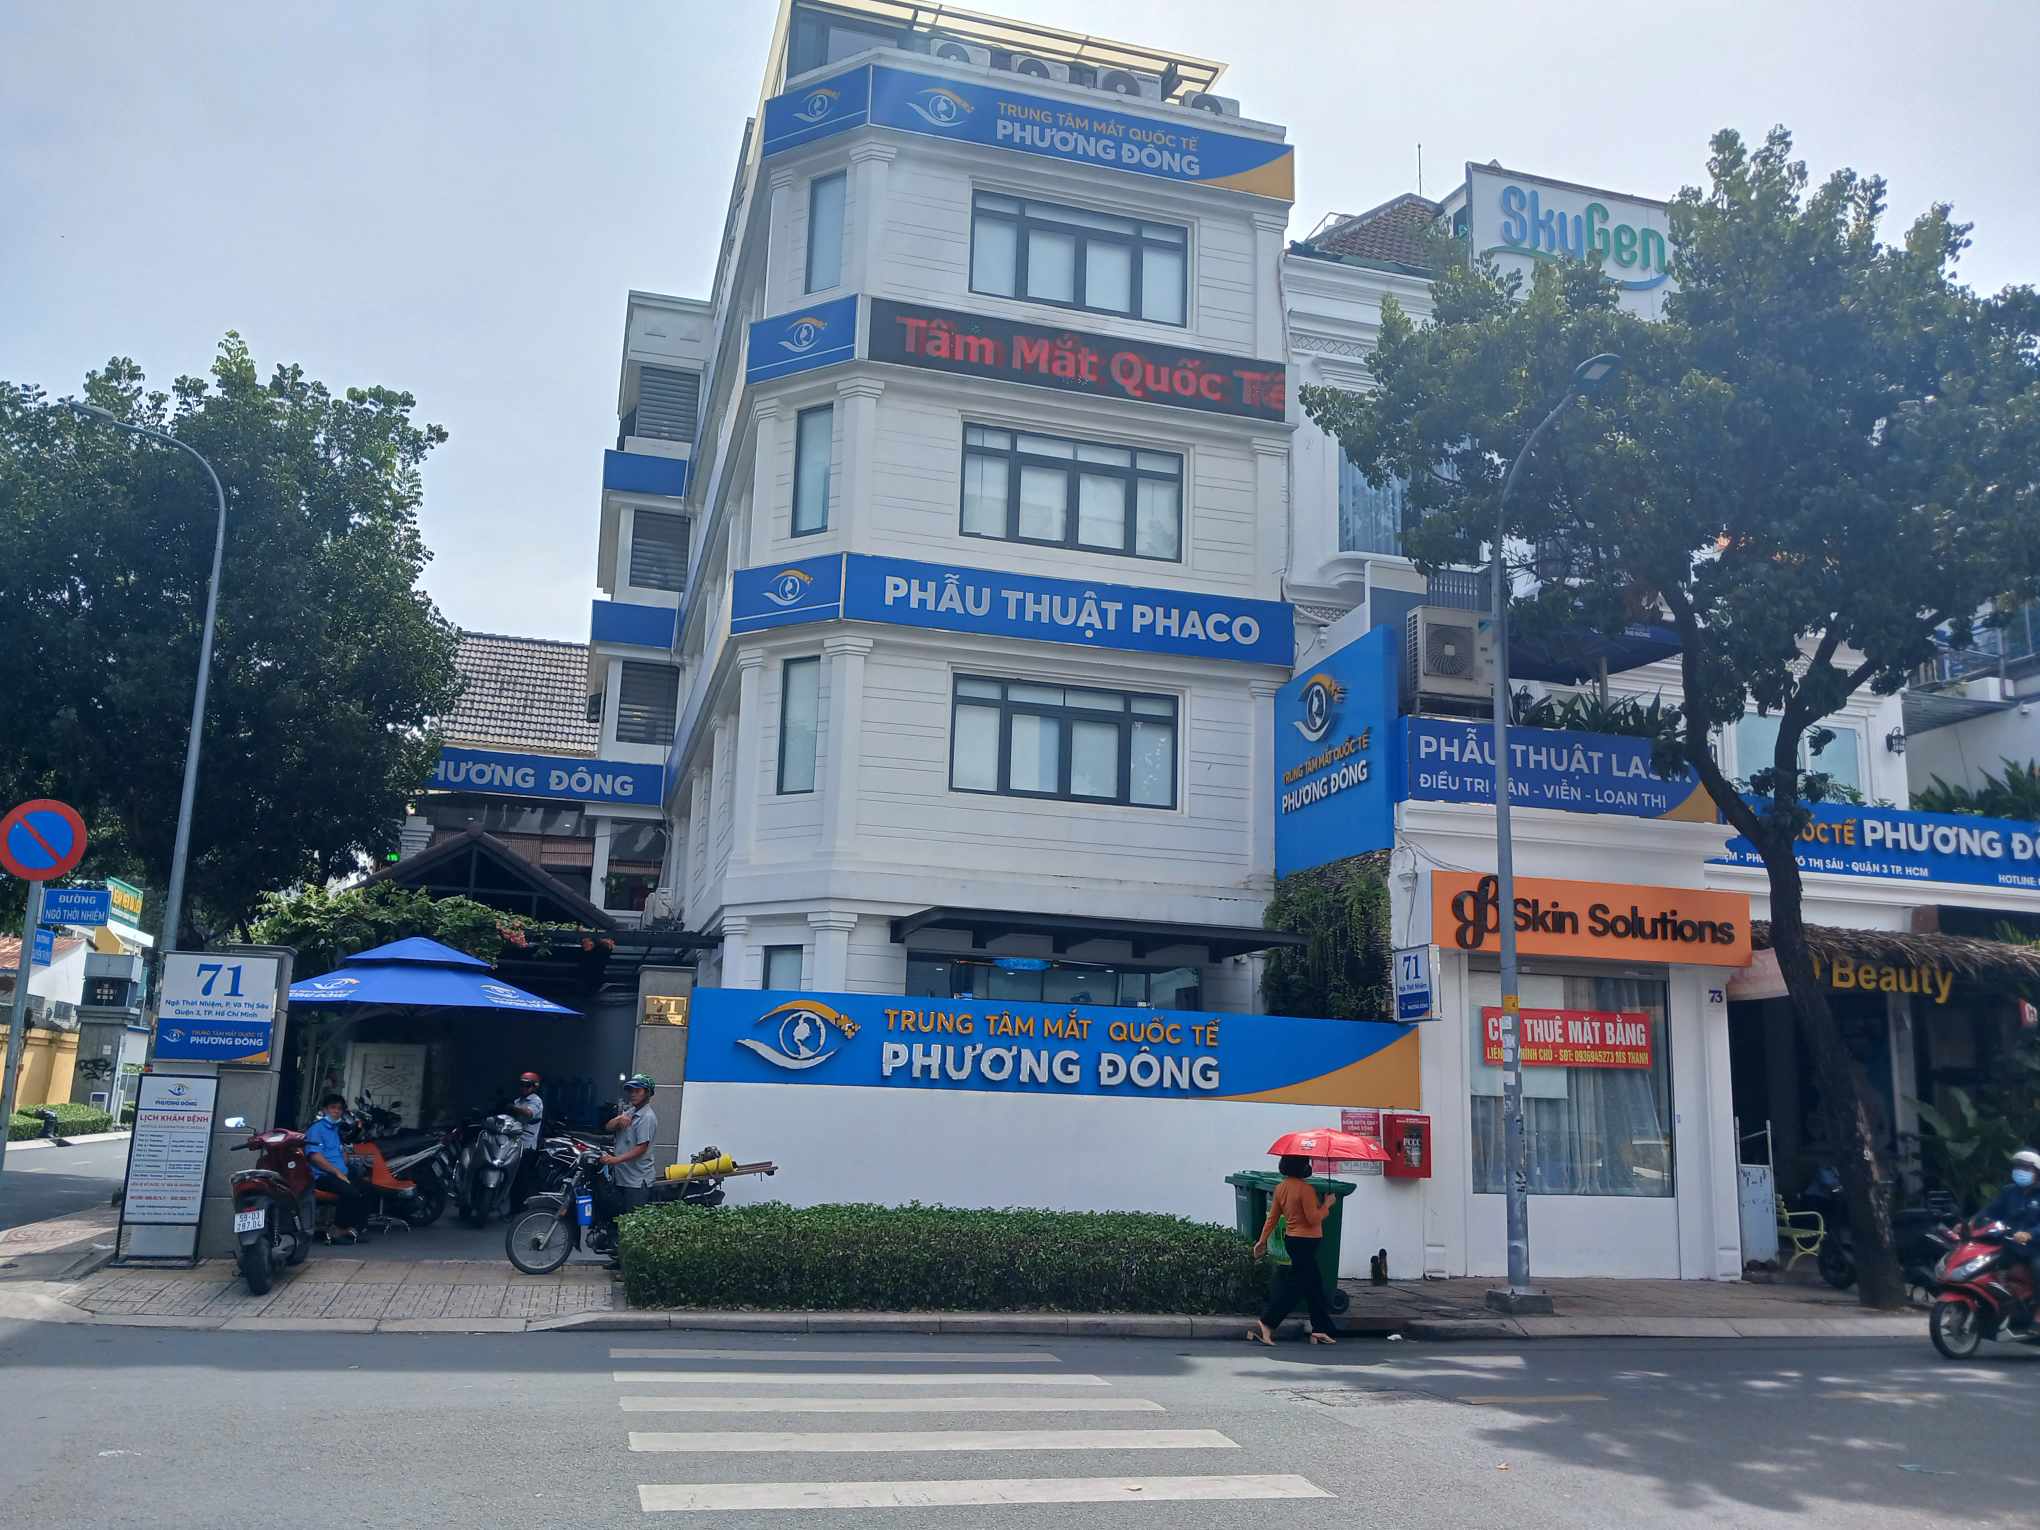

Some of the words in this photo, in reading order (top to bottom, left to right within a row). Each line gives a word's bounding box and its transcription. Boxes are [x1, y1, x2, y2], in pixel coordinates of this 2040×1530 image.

[997, 102, 1053, 124] TRUNG
[1057, 112, 1089, 131] TÂM
[1093, 118, 1126, 137] MẮT
[1129, 127, 1176, 148] QUỐC
[1180, 135, 1200, 151] TẾ
[996, 118, 1116, 160] PHƯƠNG
[1121, 142, 1200, 176] ĐÔNG
[896, 316, 996, 366] Tâm
[1011, 333, 1099, 382] Mắt
[1110, 351, 1224, 400] Quốc
[884, 573, 991, 616] PHẪU
[1001, 589, 1123, 638] THUẬT
[1131, 605, 1261, 645] PHACO
[432, 760, 536, 788] HƯƠNG
[549, 767, 634, 796] ĐÔNG
[1510, 743, 1603, 780] THUẬT
[1281, 778, 1328, 815] PHƯƠNG
[1330, 760, 1368, 795] ĐÔNG
[1419, 770, 1460, 791] ĐIỀU
[1464, 777, 1490, 797] TRỊ
[1543, 779, 1582, 801] VIỄN
[1595, 789, 1639, 808] LOẠN
[1642, 792, 1667, 812] THỊ
[1831, 818, 1857, 845] TẾ
[1863, 818, 2003, 859] PHƯƠNG
[1852, 861, 1880, 875] QUẬN
[1882, 863, 1888, 873] 3
[1905, 866, 1929, 877] HCM
[45, 908, 61, 920] NGÔ
[58, 894, 96, 904] ĐƯỜNG
[1513, 898, 1579, 935] Skin
[1588, 902, 1736, 945] Solutions
[196, 963, 244, 997] 71
[1402, 954, 1421, 980] 71
[1832, 957, 1953, 1003] Beauty
[1709, 991, 1723, 1003] 73
[190, 1037, 233, 1045] PHƯƠNG
[884, 1008, 974, 1035] TRUNG
[985, 1010, 1035, 1037] TÂM
[1043, 1008, 1093, 1040] MẮT
[1108, 1016, 1182, 1046] QUỐC
[1191, 1017, 1222, 1047] TẾ
[1524, 1015, 1564, 1043] THUÊ
[1567, 1016, 1601, 1049] MẶT
[1605, 1013, 1647, 1046] BẰNG
[882, 1041, 1081, 1085] PHƯƠNG
[1098, 1046, 1220, 1090] ĐÔNG
